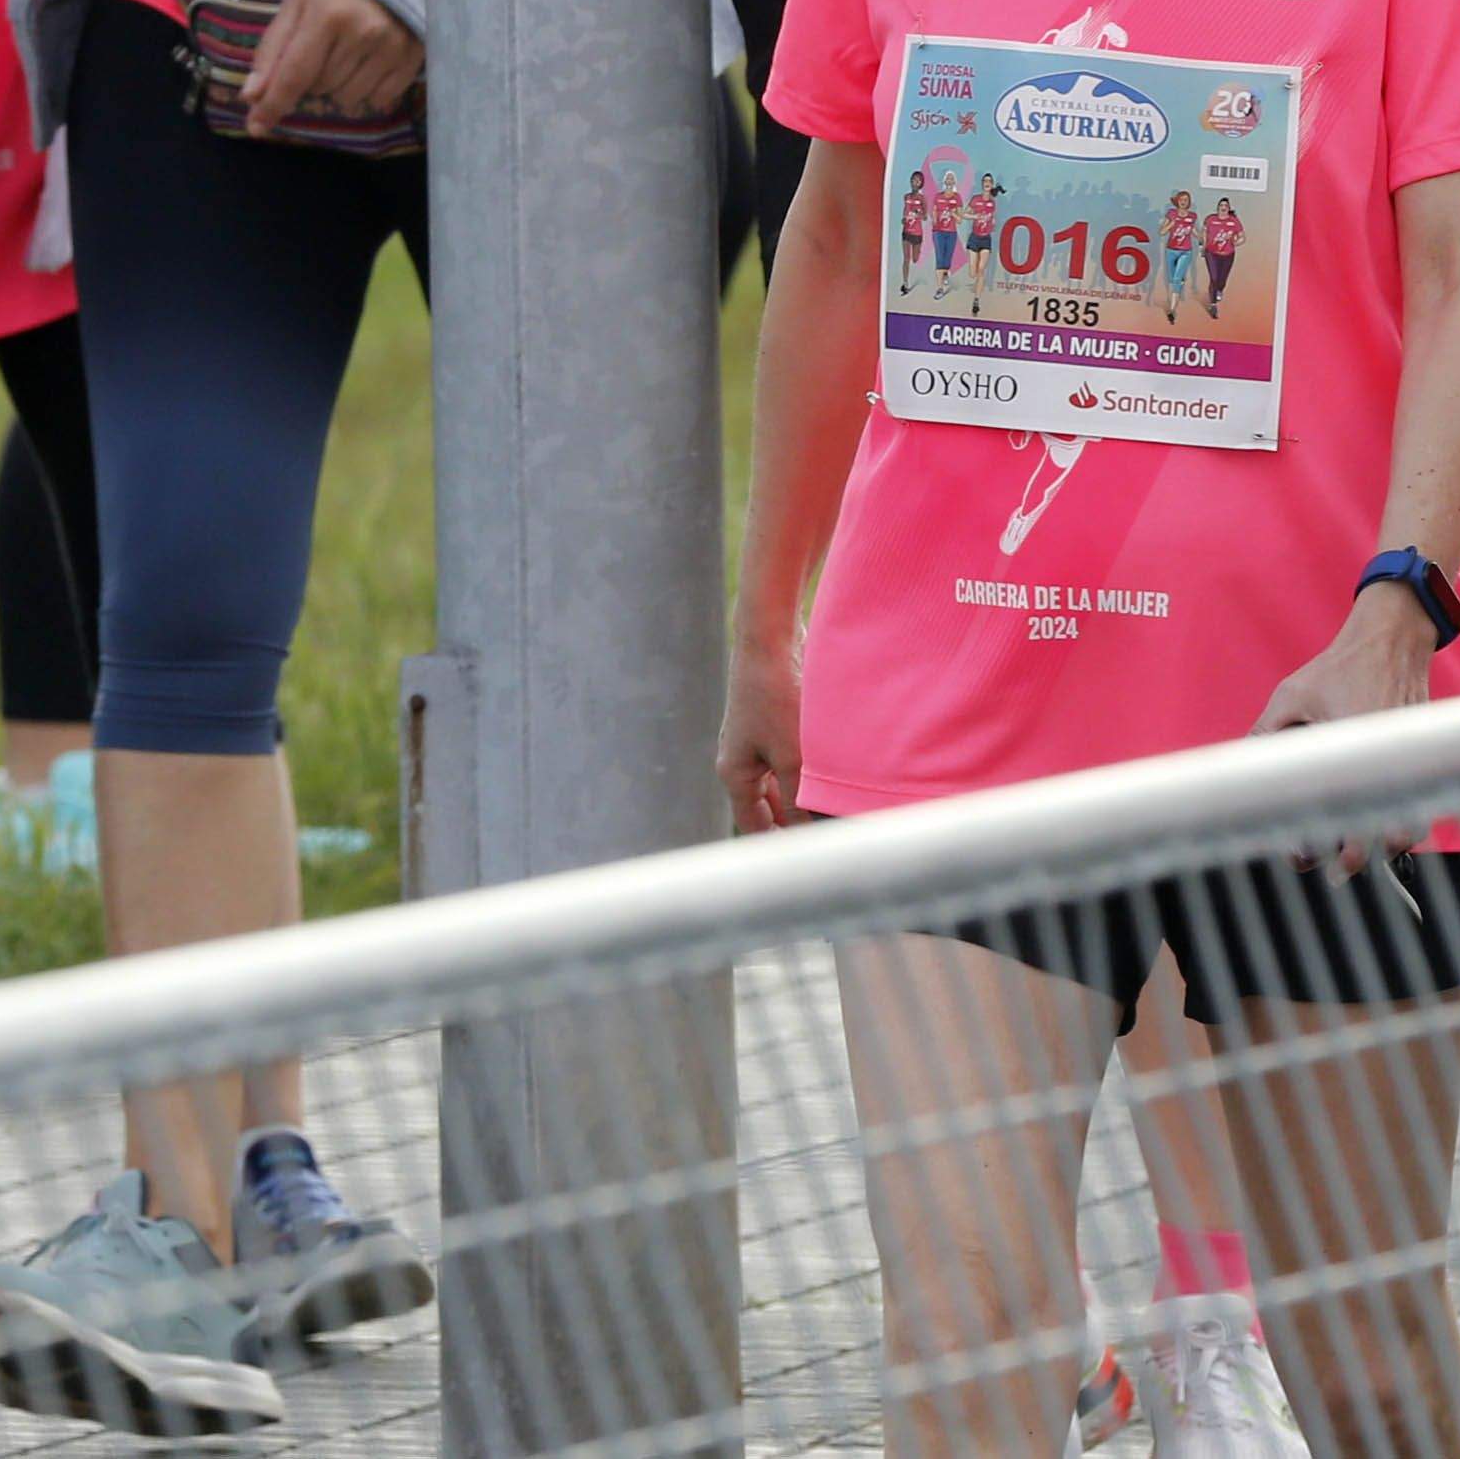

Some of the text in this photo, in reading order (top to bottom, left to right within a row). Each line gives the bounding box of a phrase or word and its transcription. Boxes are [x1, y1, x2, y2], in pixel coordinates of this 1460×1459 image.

[918, 77, 974, 100] SUMA
[922, 63, 975, 78] TU DORSAL
[1002, 99, 1157, 145] ASTURIANA
[1030, 97, 1153, 118] CENTRAL LECHERA
[999, 215, 1150, 285] 016
[1027, 296, 1100, 327] 1835
[929, 324, 1216, 368] CARRERA DE LA MUJER GIJÓN
[911, 368, 1229, 421] OYSHO Santander
[955, 577, 1170, 618] CARRERA DE LA MUJER
[1028, 615, 1079, 640] 2024
